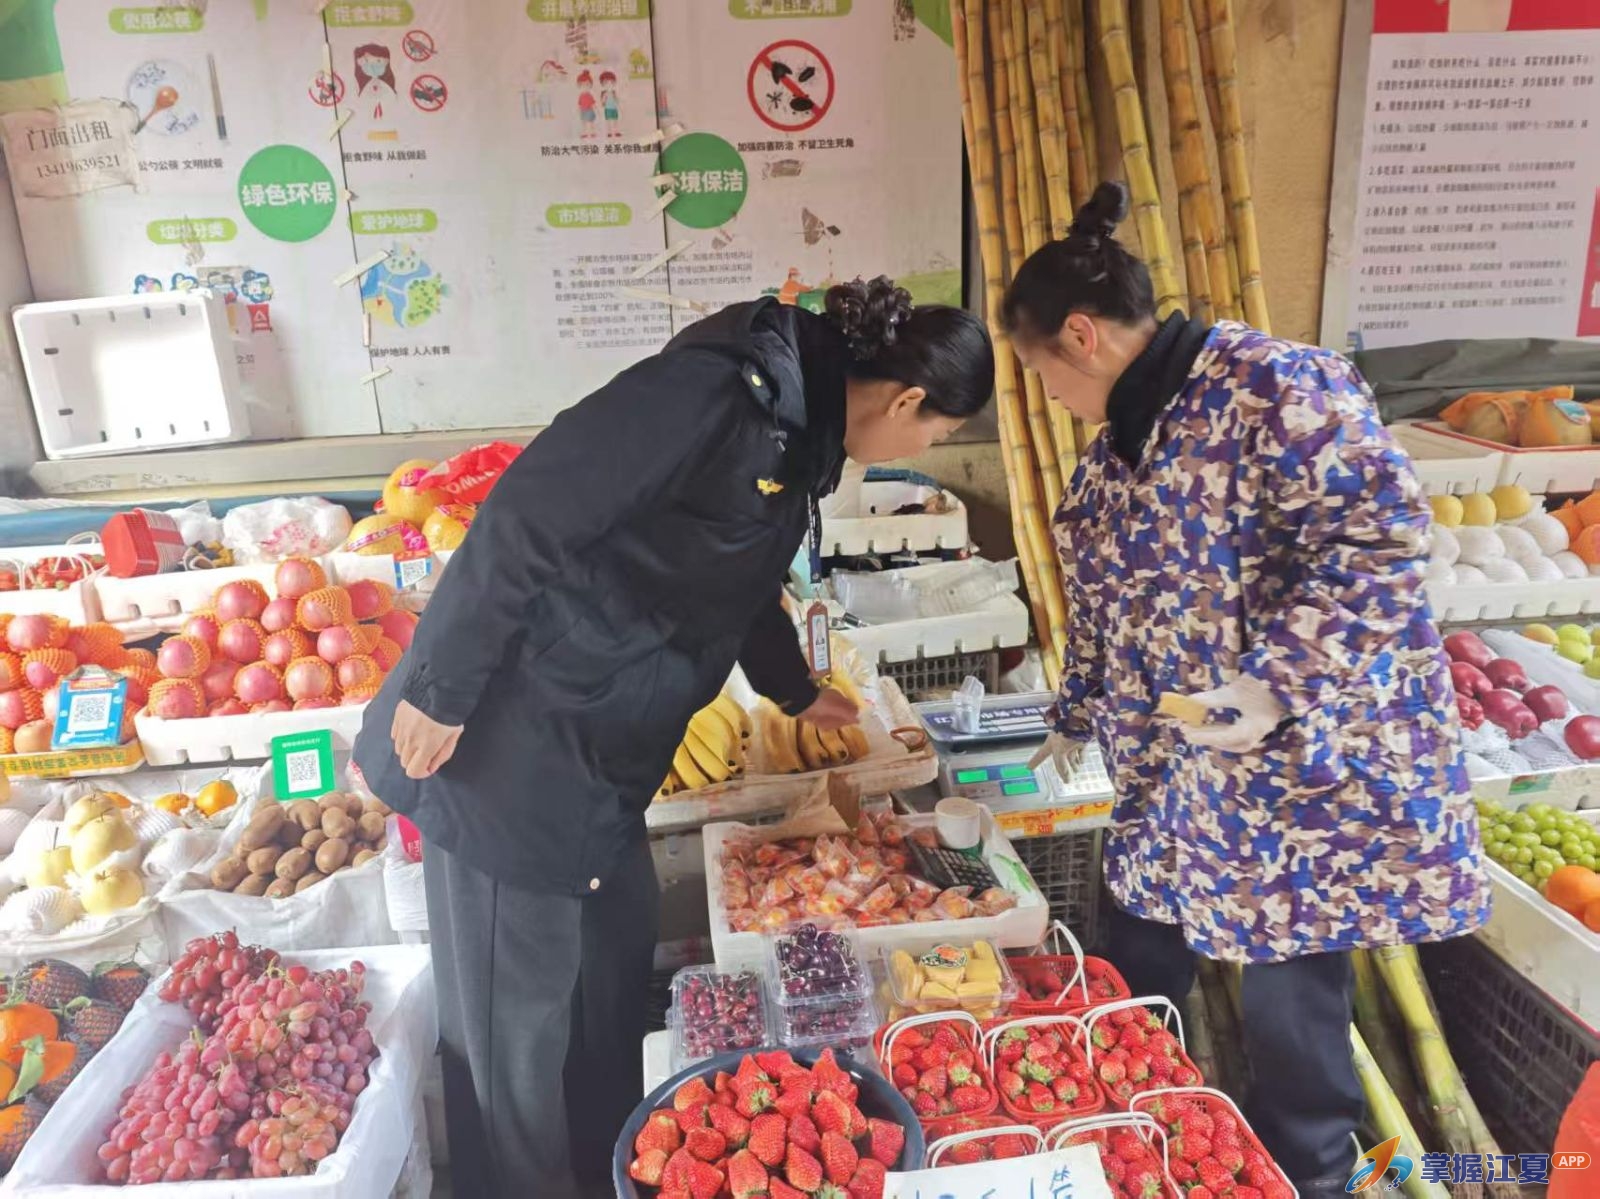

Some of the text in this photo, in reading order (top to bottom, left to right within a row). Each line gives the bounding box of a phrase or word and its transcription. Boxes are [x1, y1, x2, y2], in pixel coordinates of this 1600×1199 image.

[27, 120, 112, 151] 门面出租
[541, 145, 600, 157] 防治大气污染
[738, 137, 855, 153] 加强四害防治 不留卫生死角
[386, 150, 427, 161] 从我做起
[37, 154, 121, 178] 13419639521
[242, 181, 336, 208] 绿色环保
[558, 207, 621, 224] 市场保洁
[371, 345, 451, 358] 保护地球 人人有责
